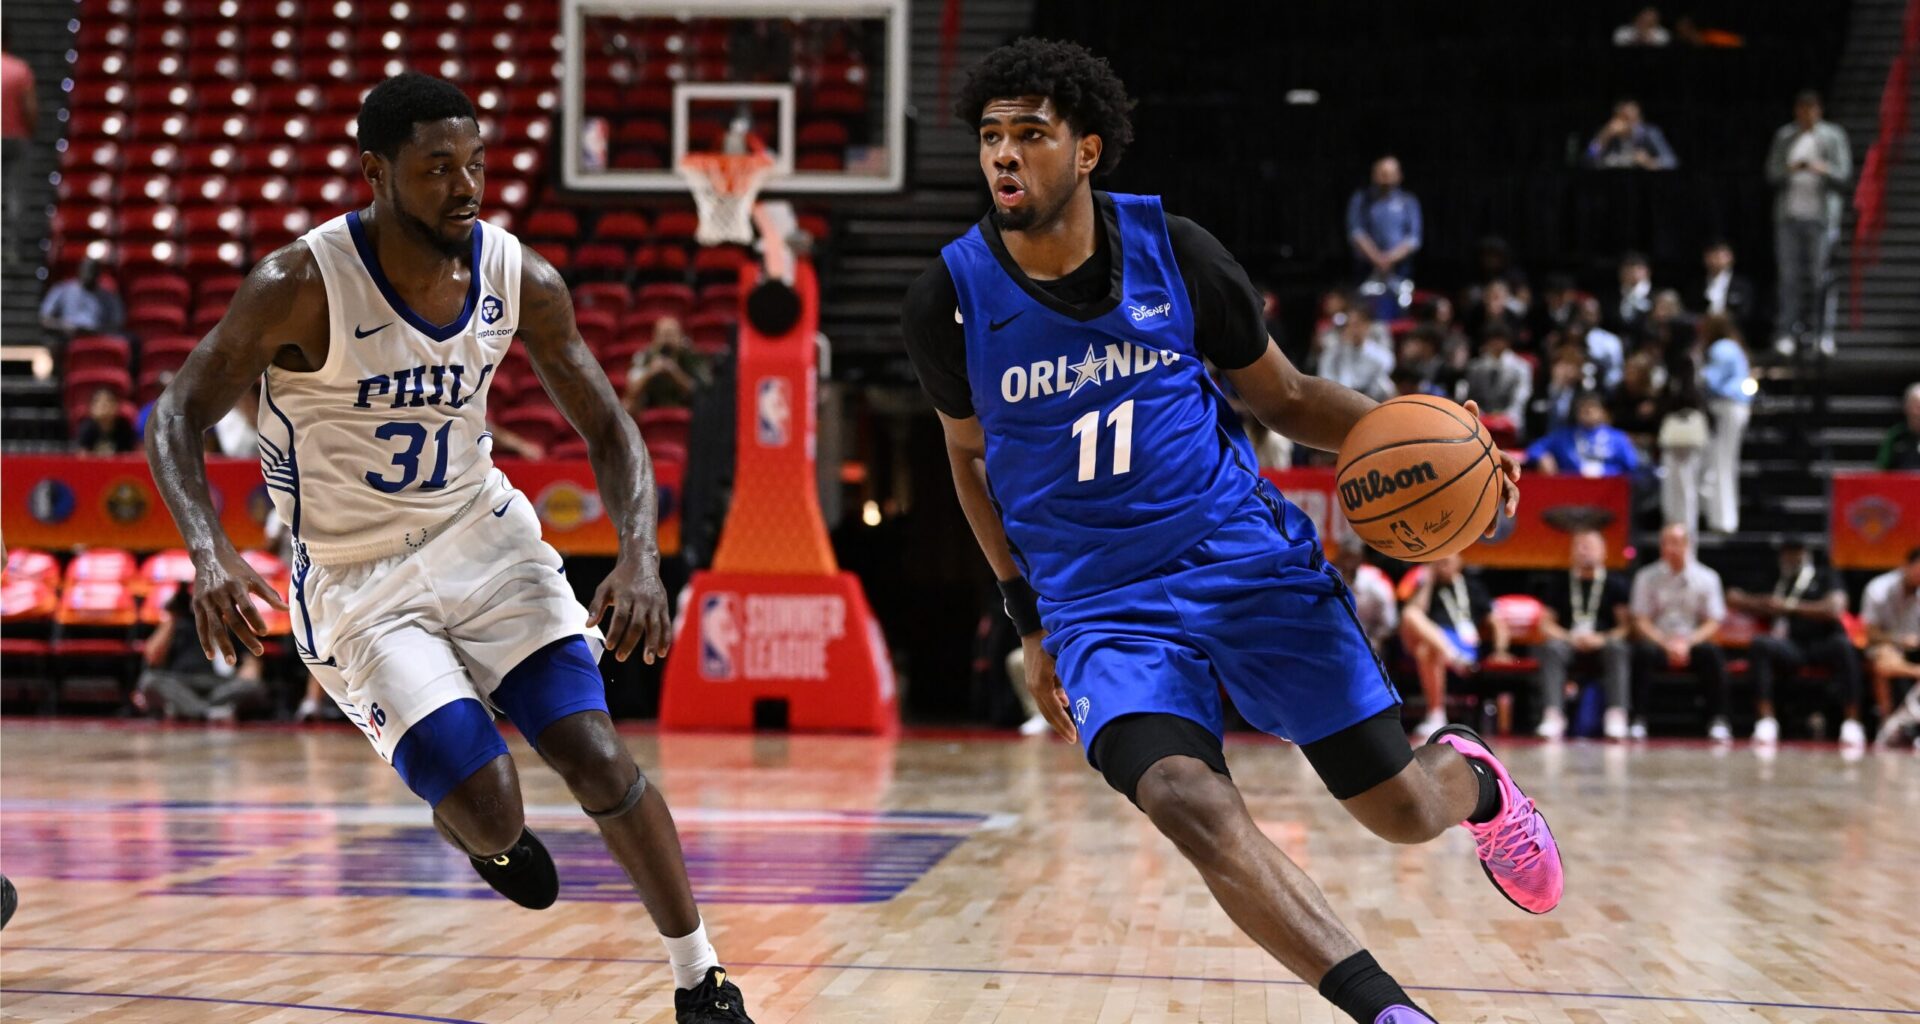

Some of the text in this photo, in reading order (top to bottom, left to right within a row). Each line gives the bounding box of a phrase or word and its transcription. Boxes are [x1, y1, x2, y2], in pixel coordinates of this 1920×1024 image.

[365, 419, 454, 494] 31
[1072, 399, 1134, 482] 11
[1340, 461, 1438, 512] Wilson
[744, 593, 846, 638] SUMMER
[742, 638, 829, 681] LEAGUE
